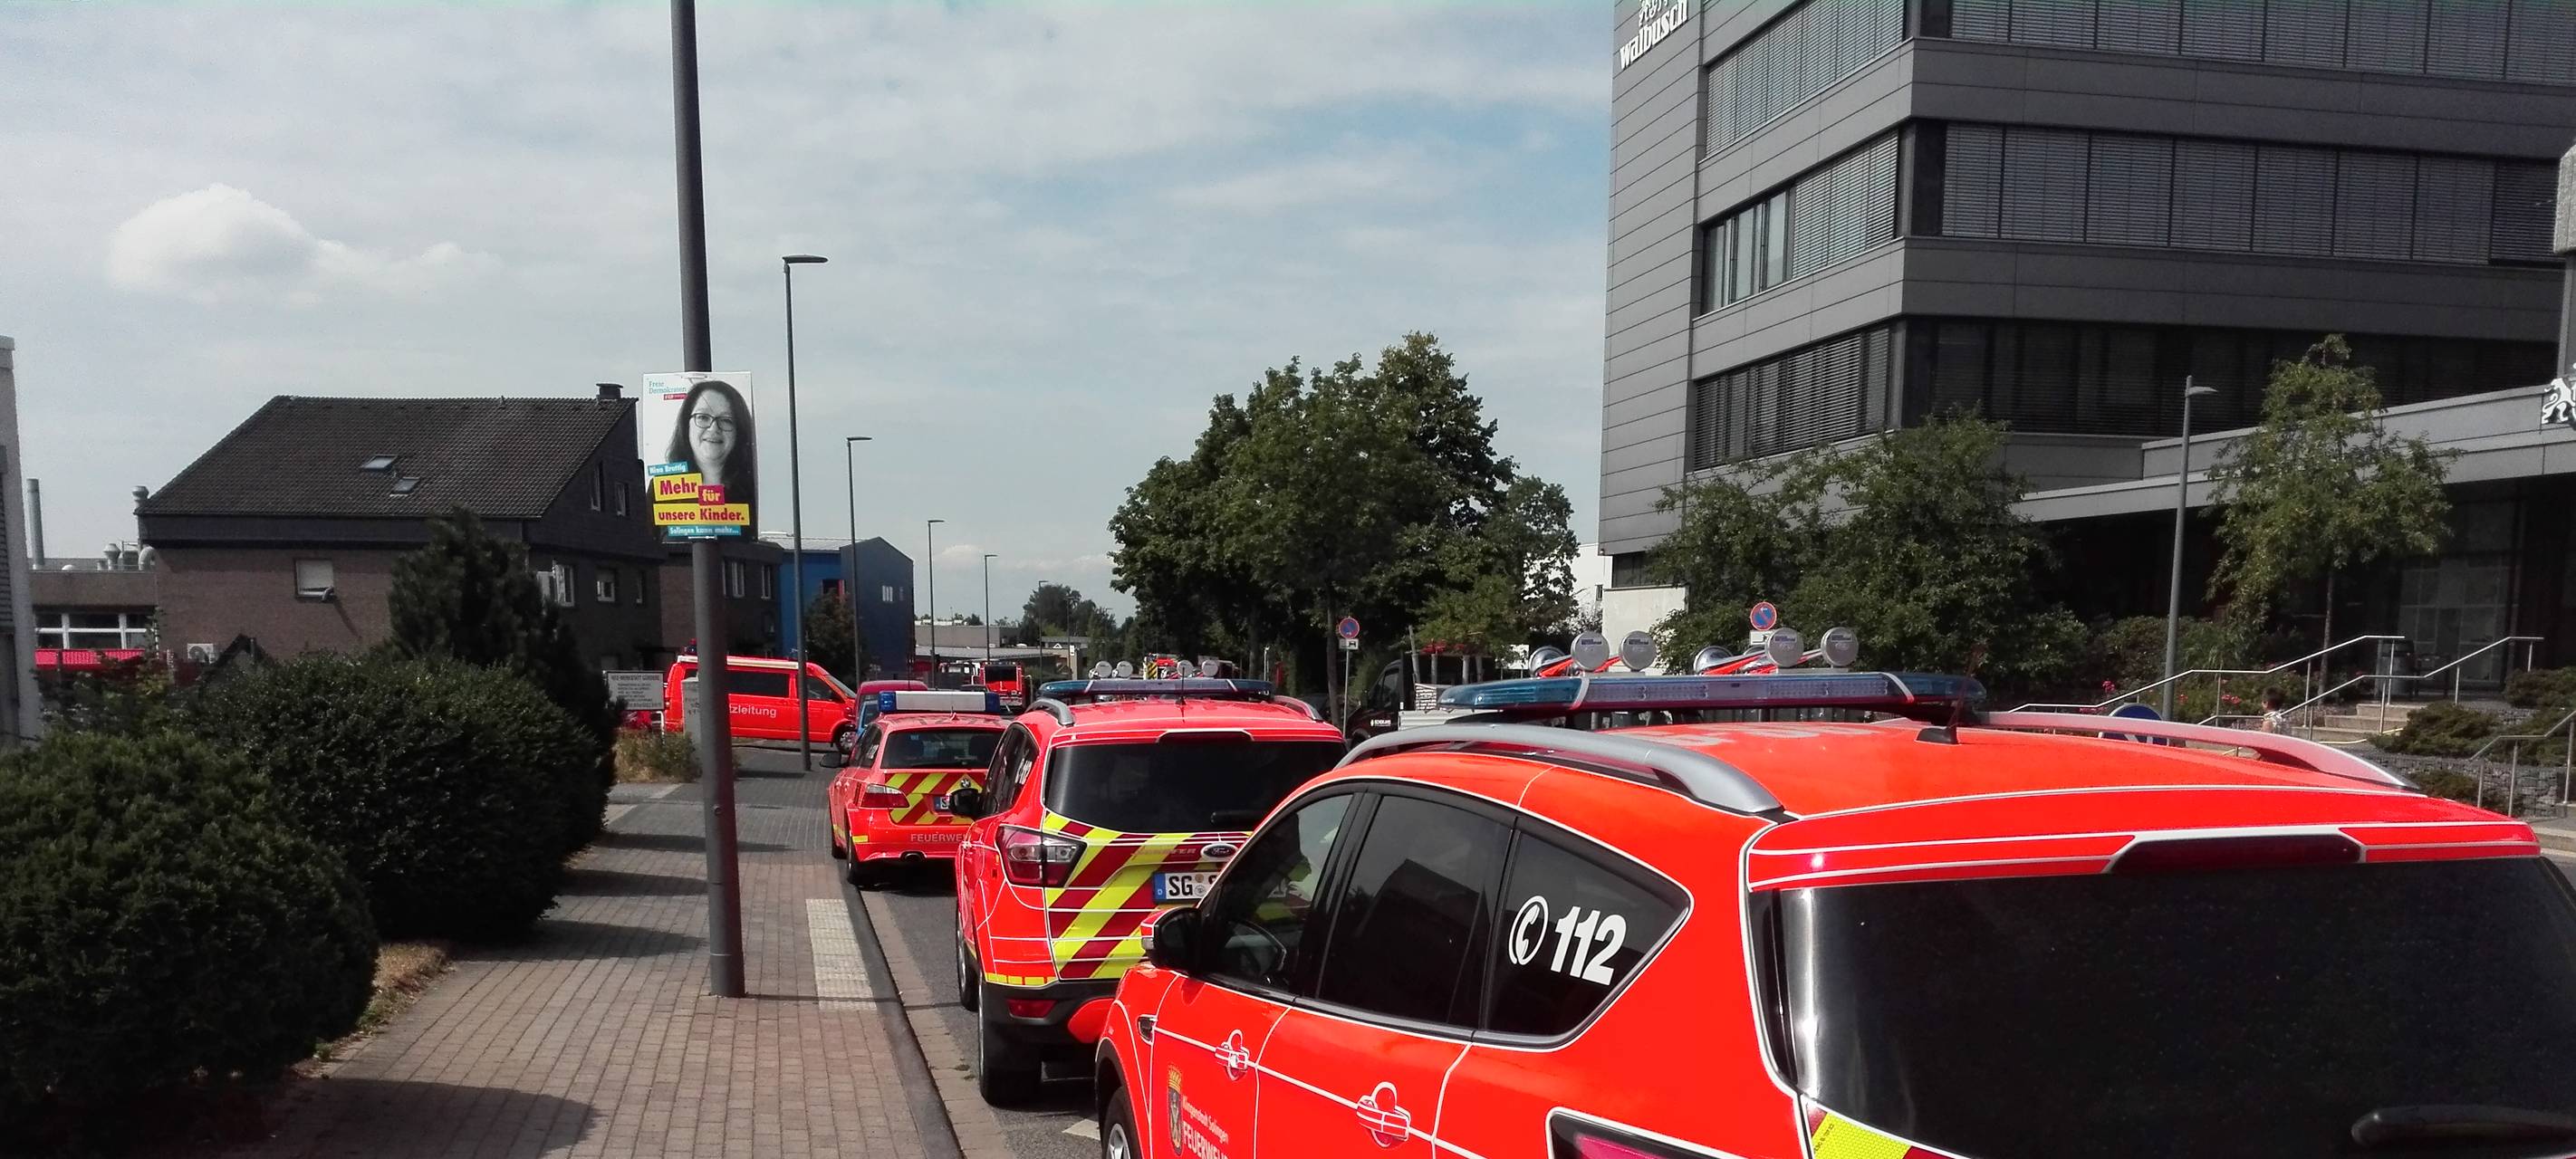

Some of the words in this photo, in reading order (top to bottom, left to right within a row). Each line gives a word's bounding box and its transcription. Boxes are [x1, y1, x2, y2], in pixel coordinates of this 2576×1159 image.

[1620, 0, 1687, 70] walbusch
[659, 477, 697, 495] Mehr
[702, 489, 721, 502] für
[658, 511, 696, 521] unsere
[699, 508, 745, 521] Kinder.
[1168, 875, 1193, 896] SG
[1551, 905, 1627, 986] 112
